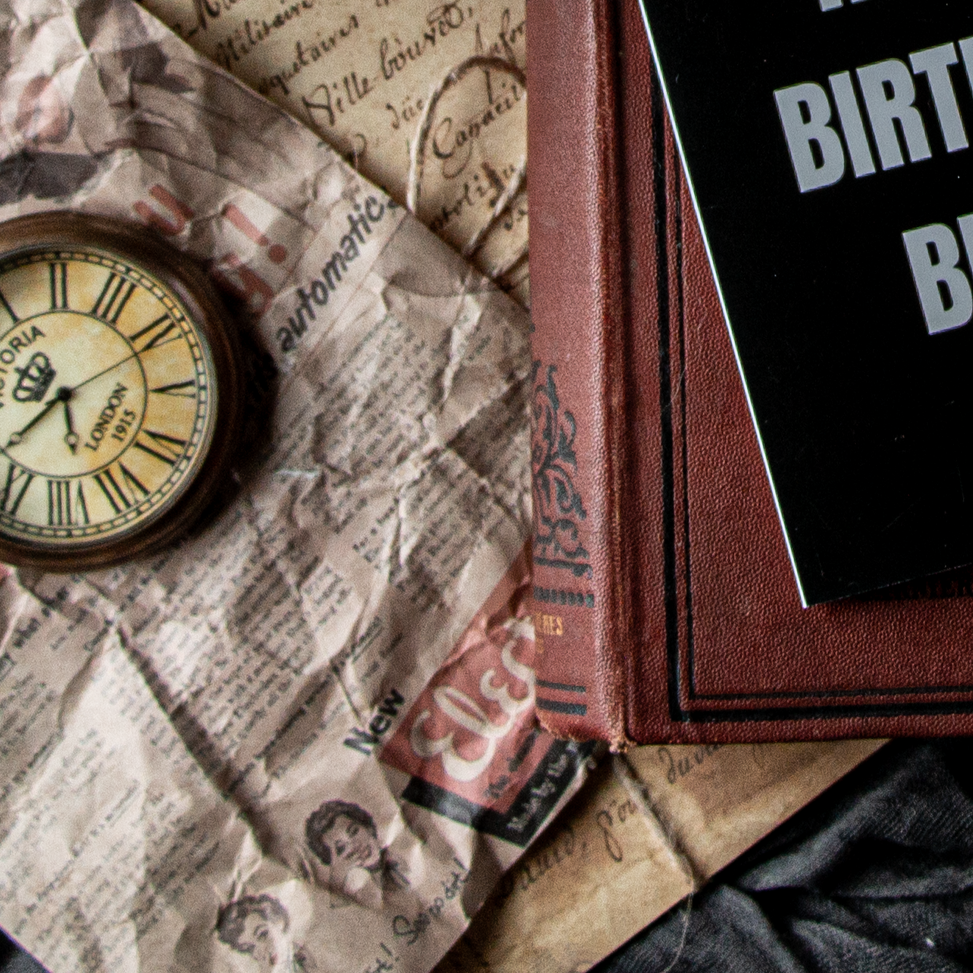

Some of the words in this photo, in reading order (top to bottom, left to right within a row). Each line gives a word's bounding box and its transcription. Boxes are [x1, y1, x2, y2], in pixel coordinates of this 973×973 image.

[84, 382, 129, 452] LONDON
[111, 410, 137, 443] 1915
[342, 688, 407, 755] New
